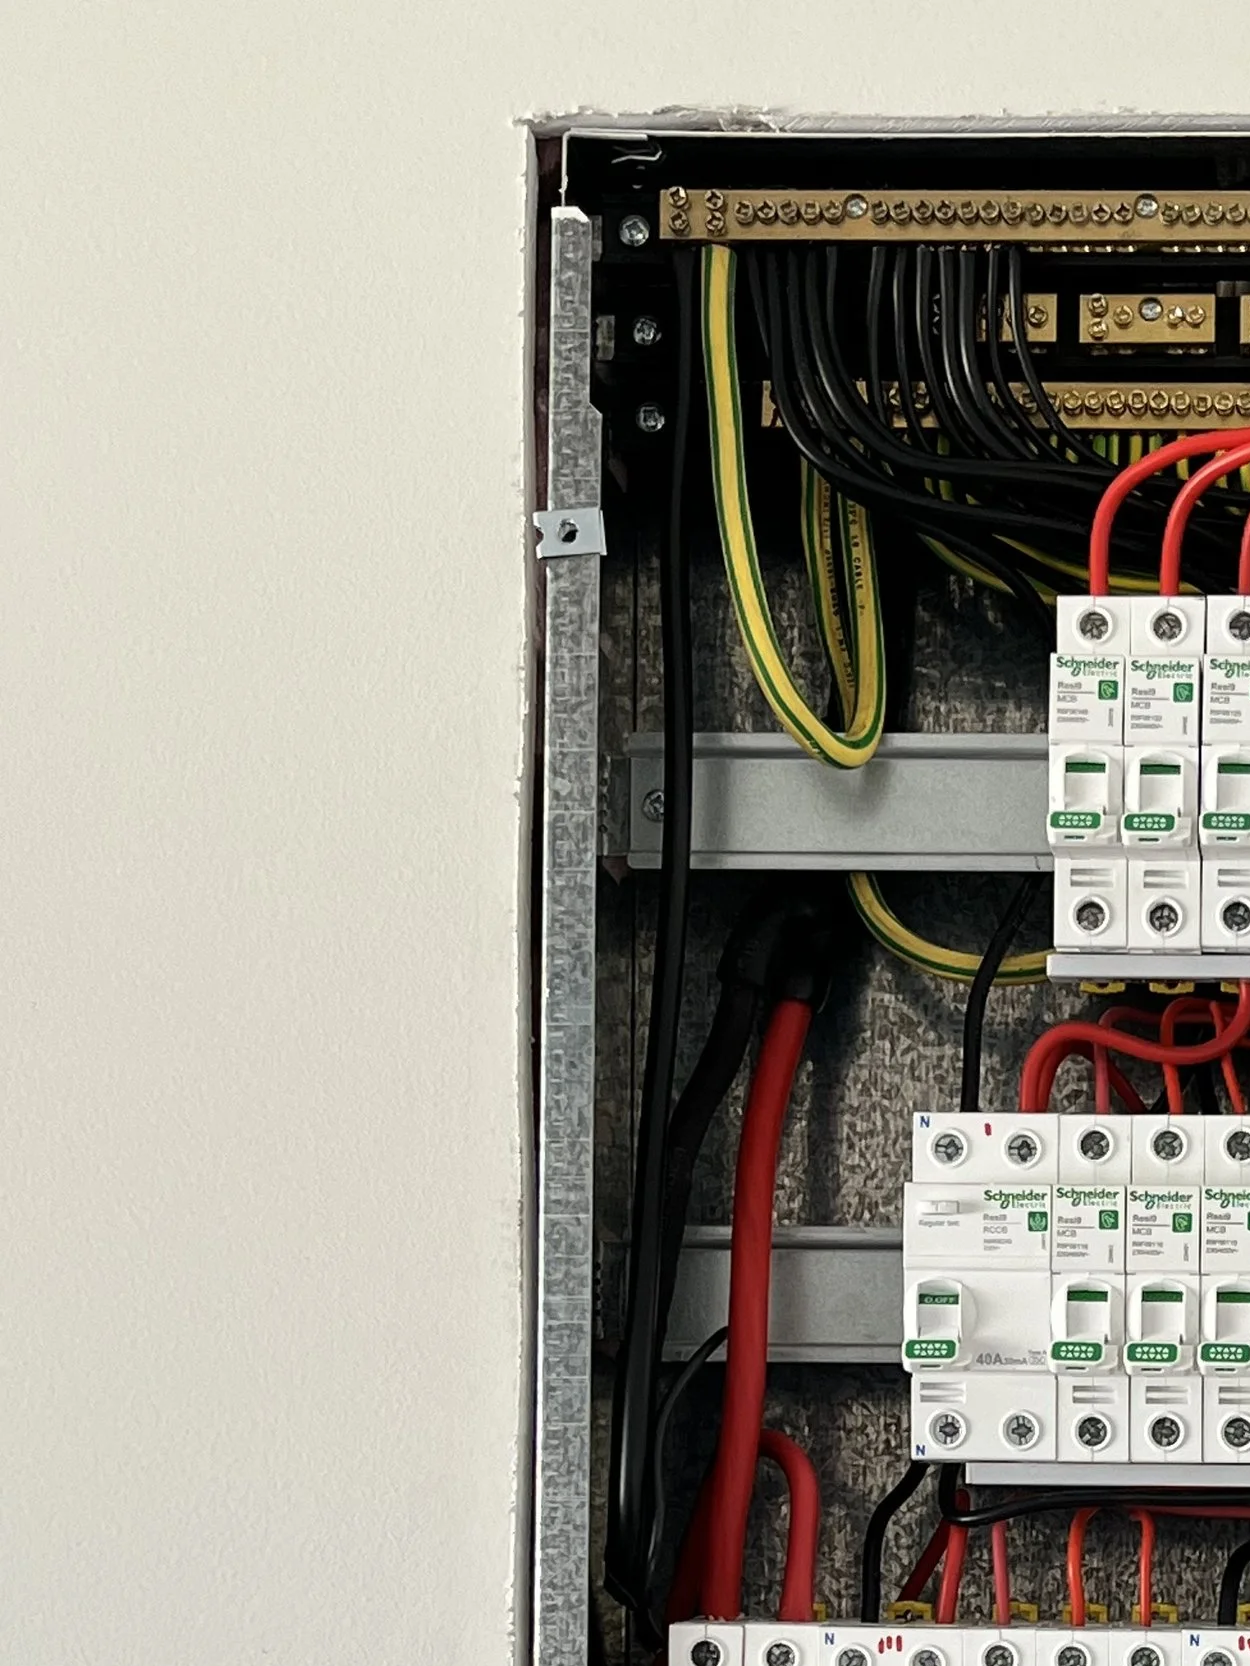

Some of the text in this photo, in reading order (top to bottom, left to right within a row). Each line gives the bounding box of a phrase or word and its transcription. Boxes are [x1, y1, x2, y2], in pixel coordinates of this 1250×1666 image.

[1056, 656, 1120, 677] Schneider
[1131, 660, 1194, 680] Schneider
[919, 1116, 930, 1128] N
[983, 1190, 1048, 1209] Schneider
[1056, 1187, 1119, 1207] Schneider
[1129, 1190, 1193, 1210] Schneider
[976, 1353, 1004, 1366] 40A
[915, 1445, 926, 1456] N
[825, 1633, 835, 1645] N
[1190, 1634, 1200, 1647] N
